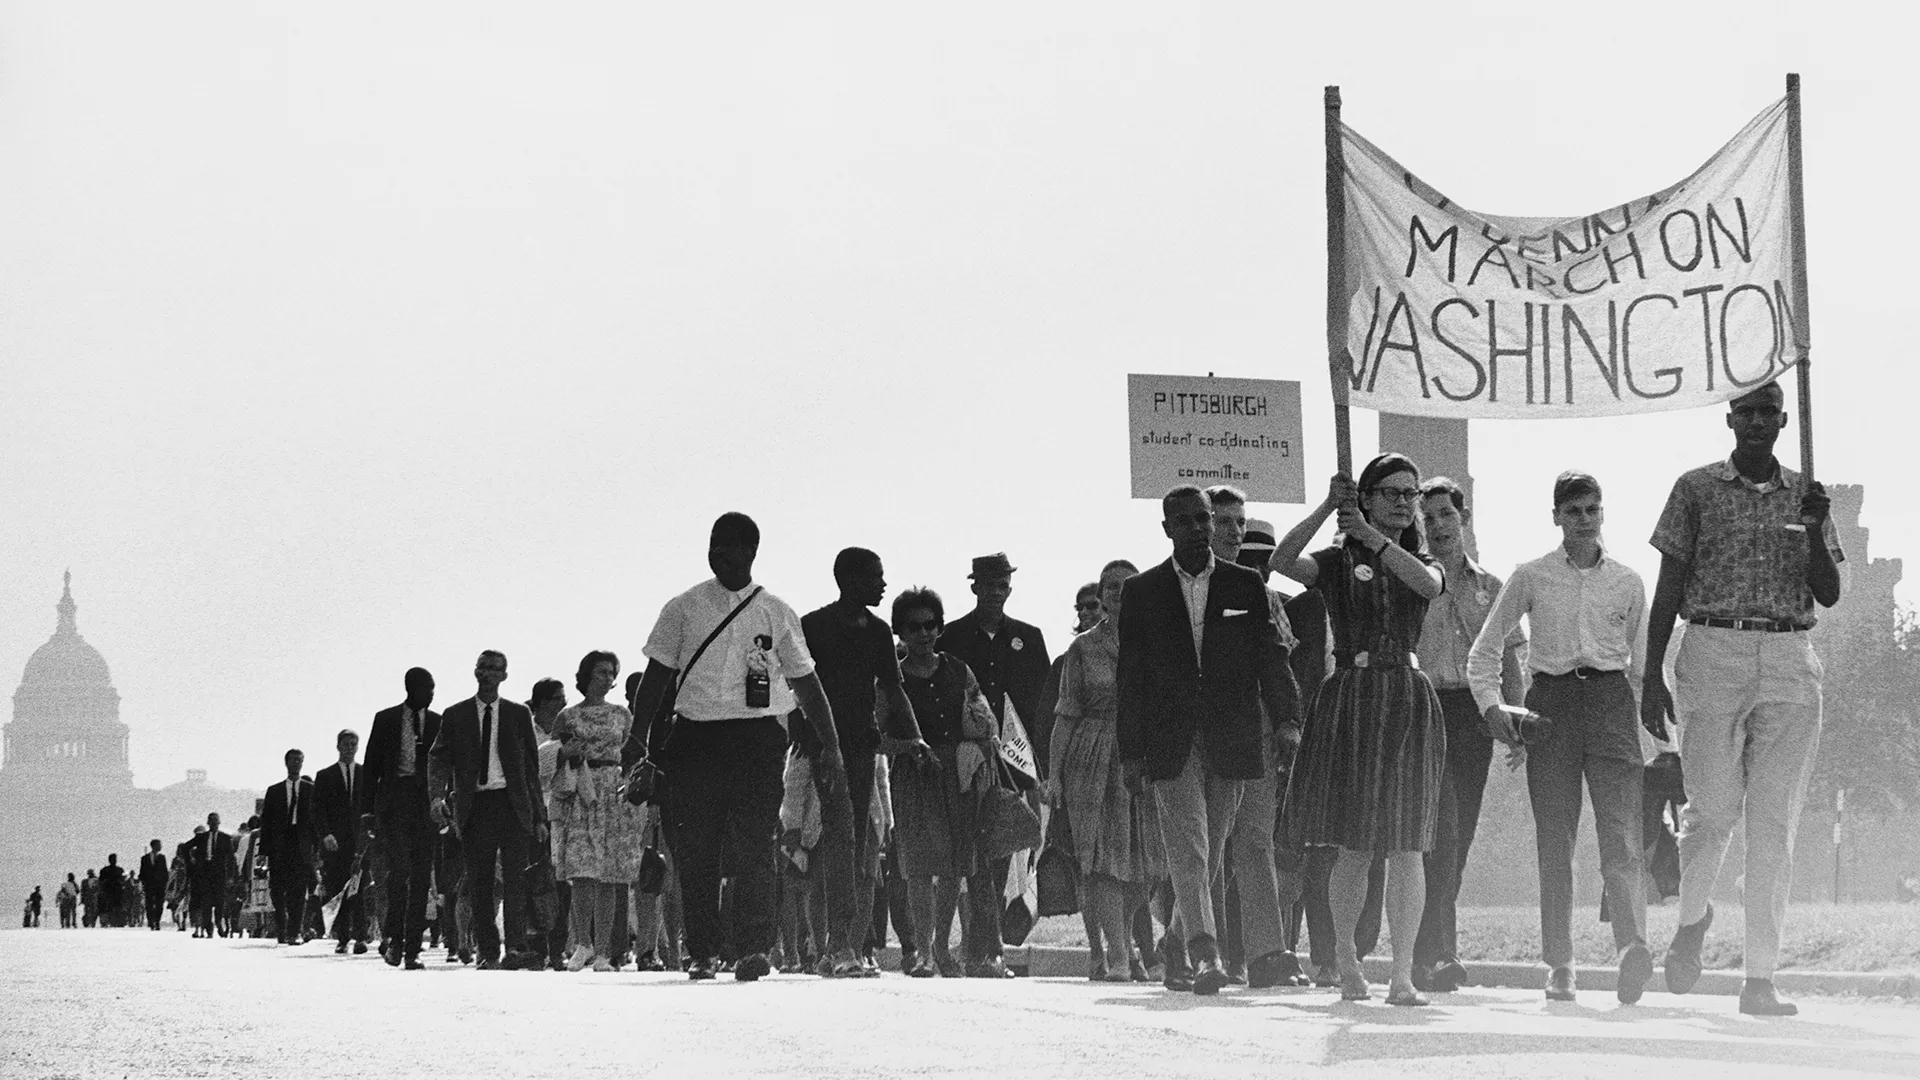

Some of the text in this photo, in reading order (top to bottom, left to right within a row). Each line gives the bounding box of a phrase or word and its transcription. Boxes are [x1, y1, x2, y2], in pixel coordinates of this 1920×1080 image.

[1405, 197, 1752, 299] MARCH ON
[1154, 392, 1268, 416] PITTSBURGH
[1142, 430, 1192, 446] student
[1178, 463, 1251, 480] committee
